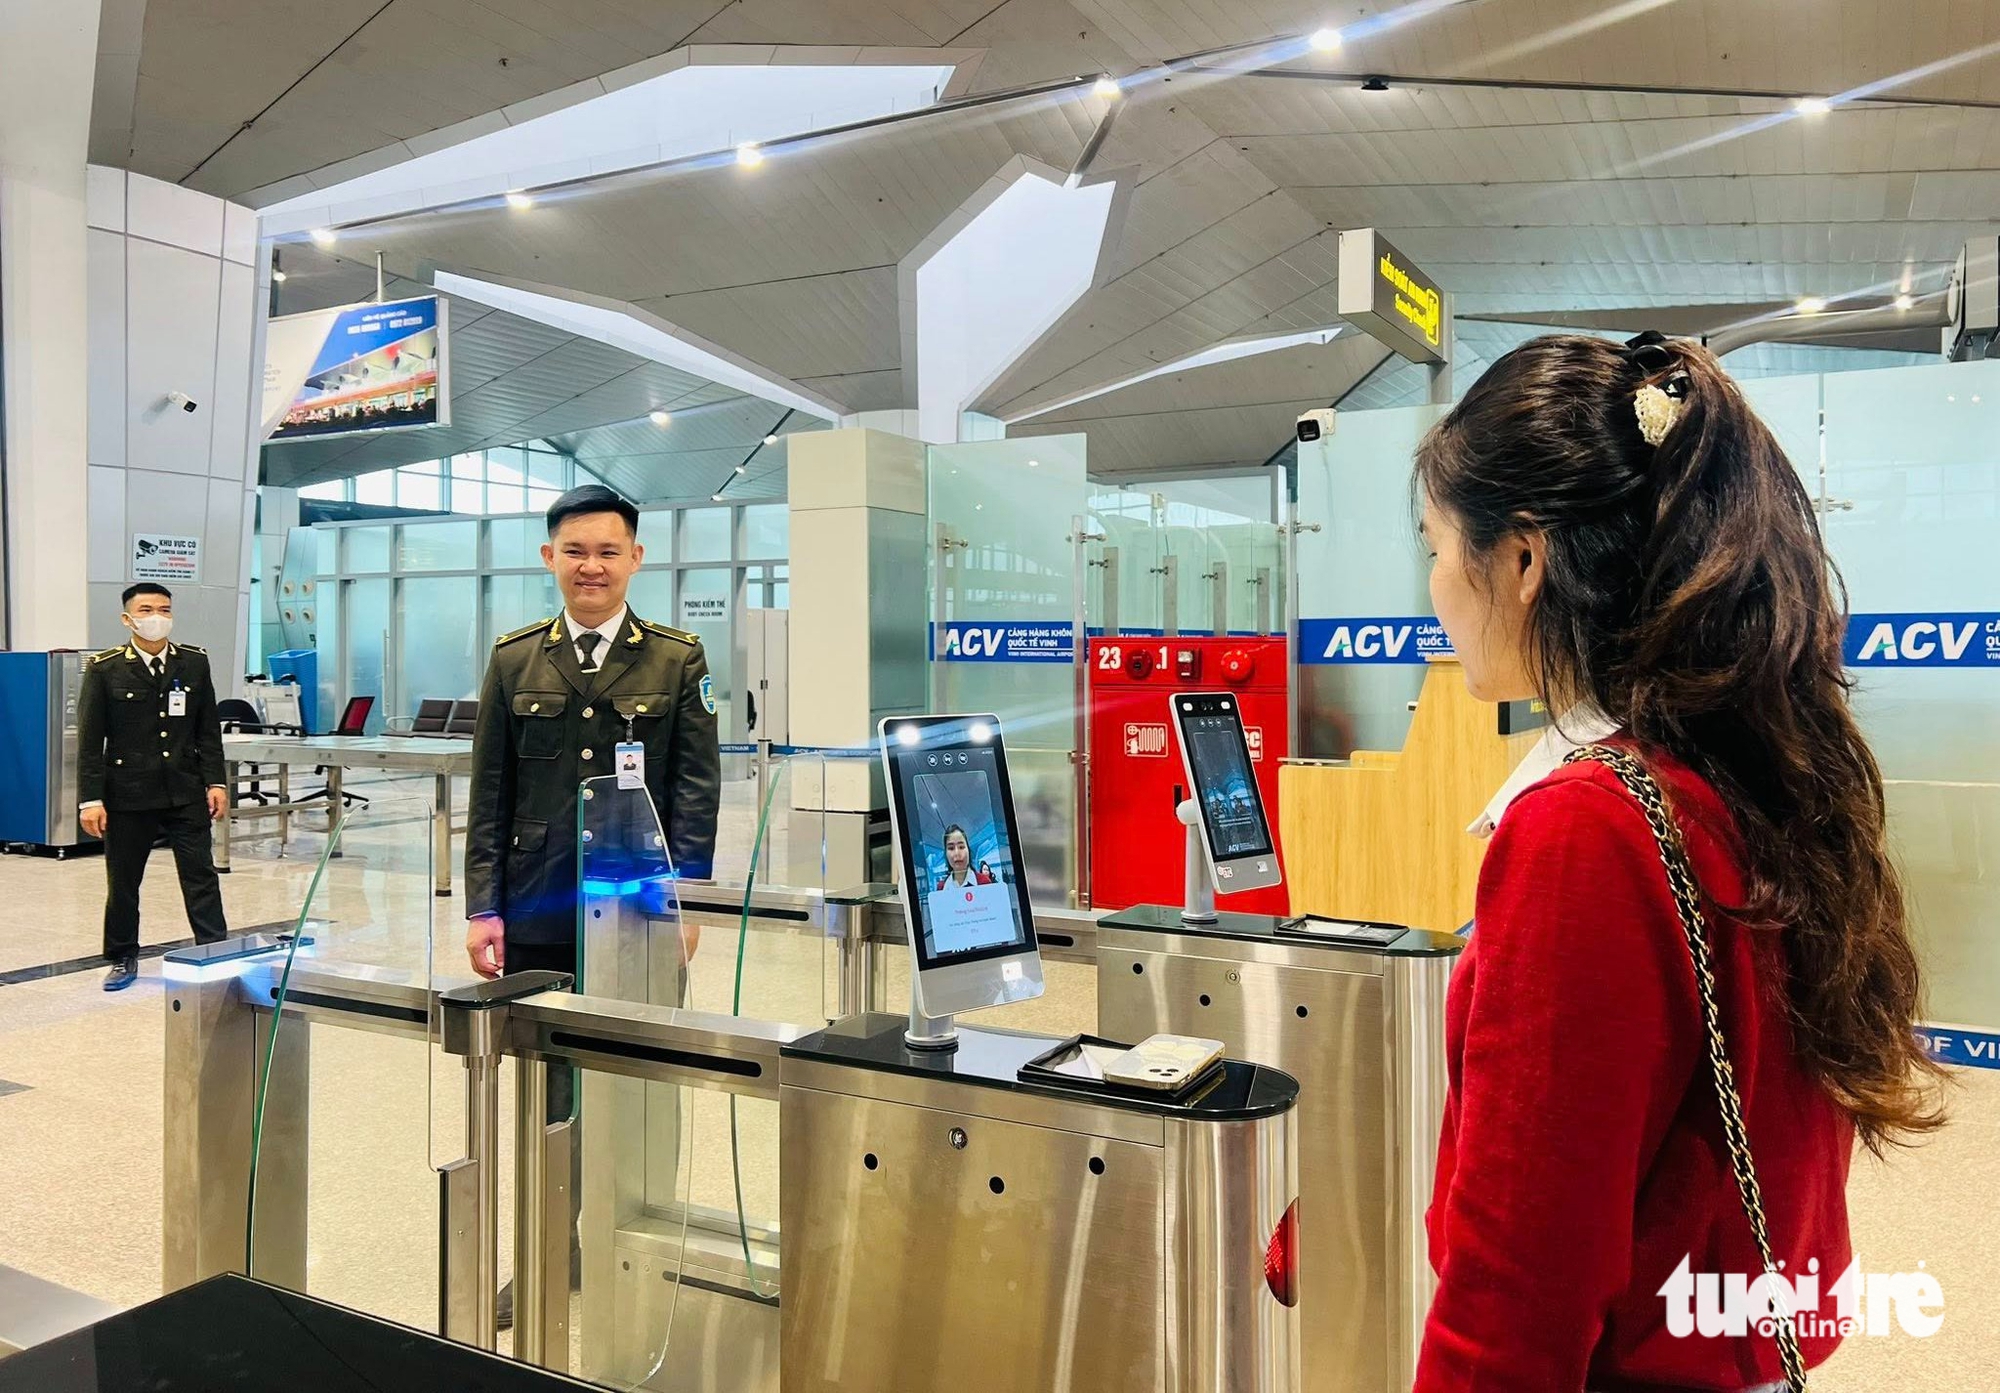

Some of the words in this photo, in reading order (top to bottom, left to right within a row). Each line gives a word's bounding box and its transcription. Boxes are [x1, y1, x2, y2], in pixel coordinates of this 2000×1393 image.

[1008, 627, 1028, 637] CẢNG
[1029, 627, 1050, 637] HÀNG
[1051, 627, 1073, 637] KHÔN
[1416, 623, 1444, 635] CẢNG
[945, 628, 1005, 656] ACV
[1008, 636, 1028, 648] QUỐC
[1029, 636, 1038, 647] TẾ
[1039, 639, 1058, 647] VINH
[1323, 625, 1412, 658] ACV
[1416, 634, 1443, 648] QUỐC
[1857, 621, 1980, 660] ACV
[1099, 646, 1121, 670] 23
